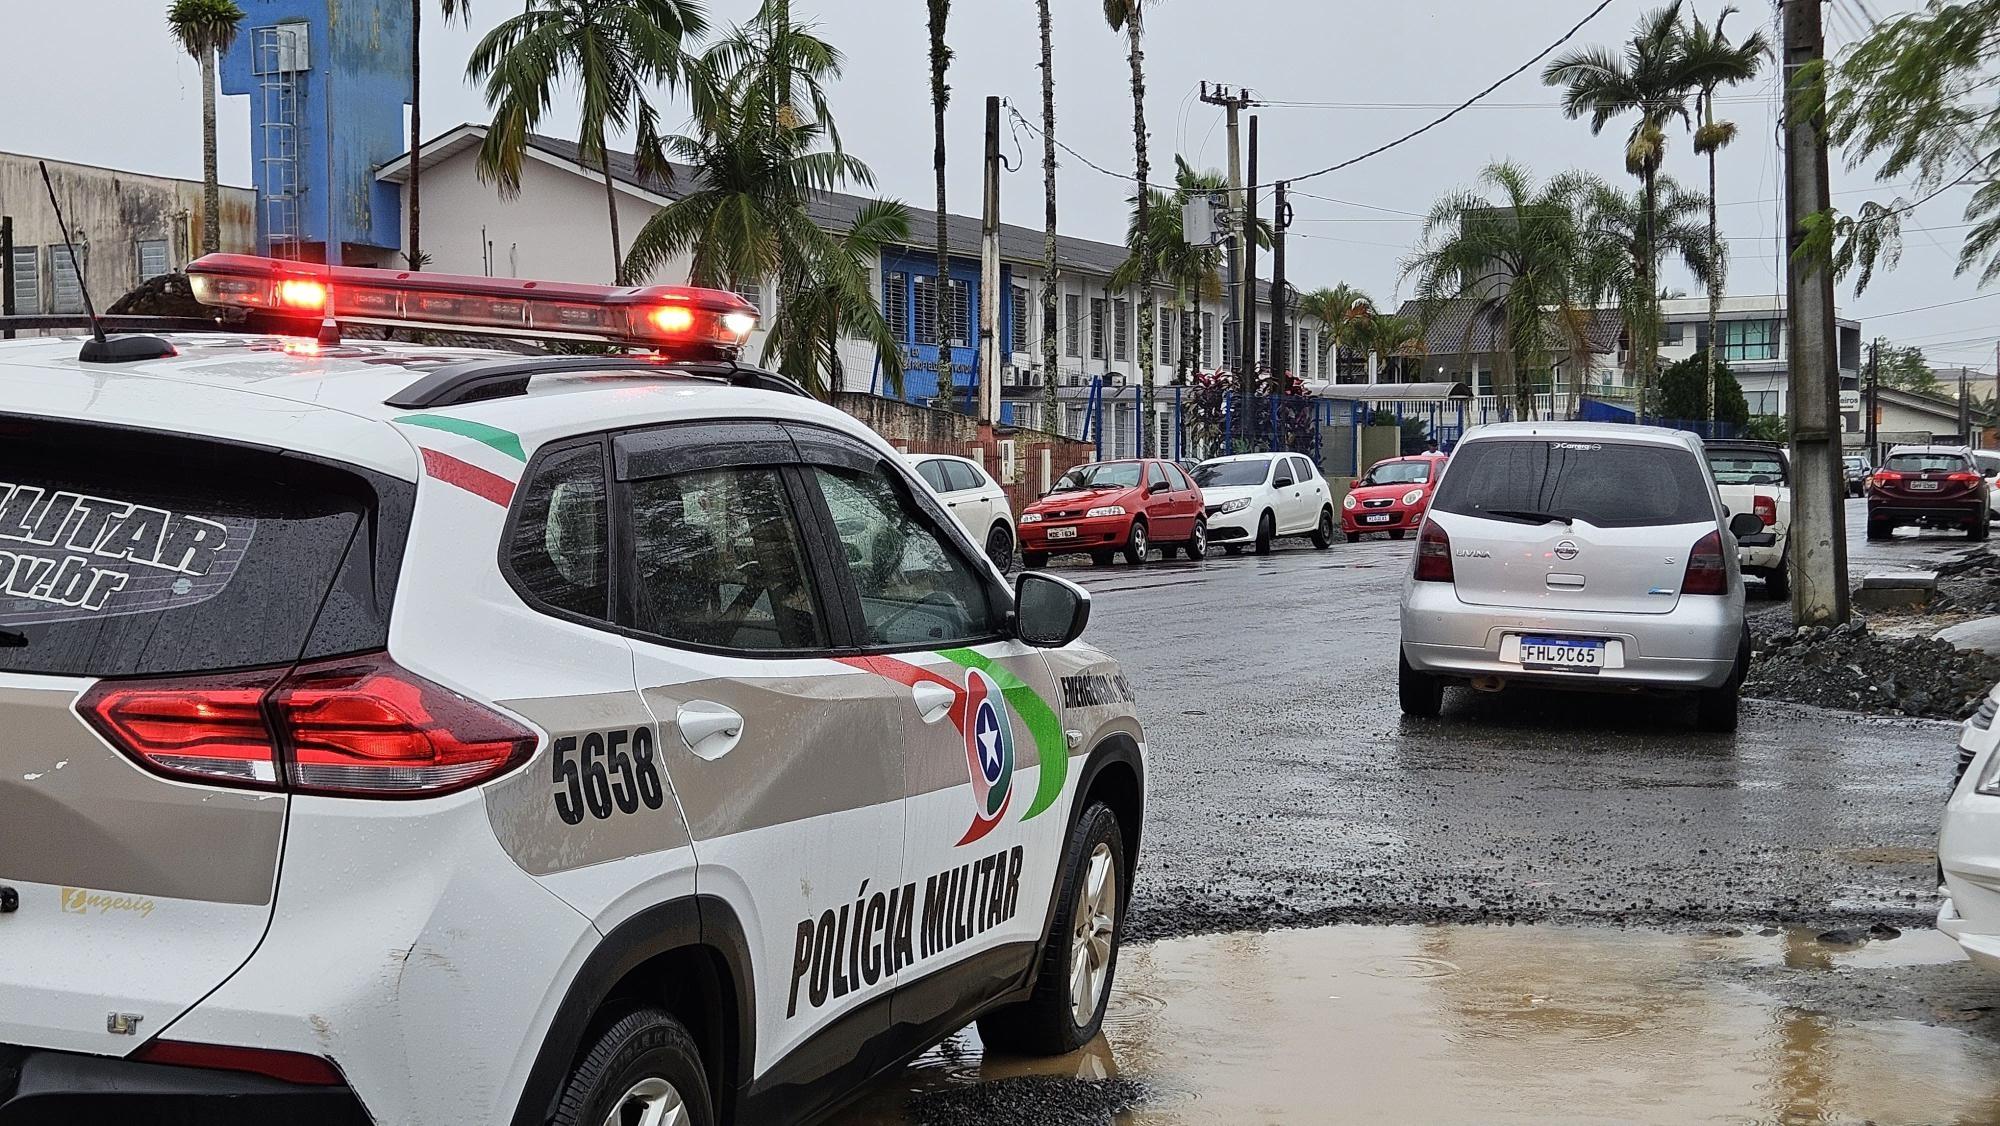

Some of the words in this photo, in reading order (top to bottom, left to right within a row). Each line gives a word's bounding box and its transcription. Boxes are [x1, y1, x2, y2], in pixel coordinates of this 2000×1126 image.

[1561, 442, 1591, 451] Carrera
[1456, 548, 1492, 559] LIVINA
[1664, 556, 1675, 565] S
[1526, 645, 1595, 664] FHL9C65
[553, 726, 664, 826] 5658
[786, 878, 916, 1020] POLÍCIA
[920, 844, 1024, 960] MILITAR
[107, 1011, 144, 1035] LT
